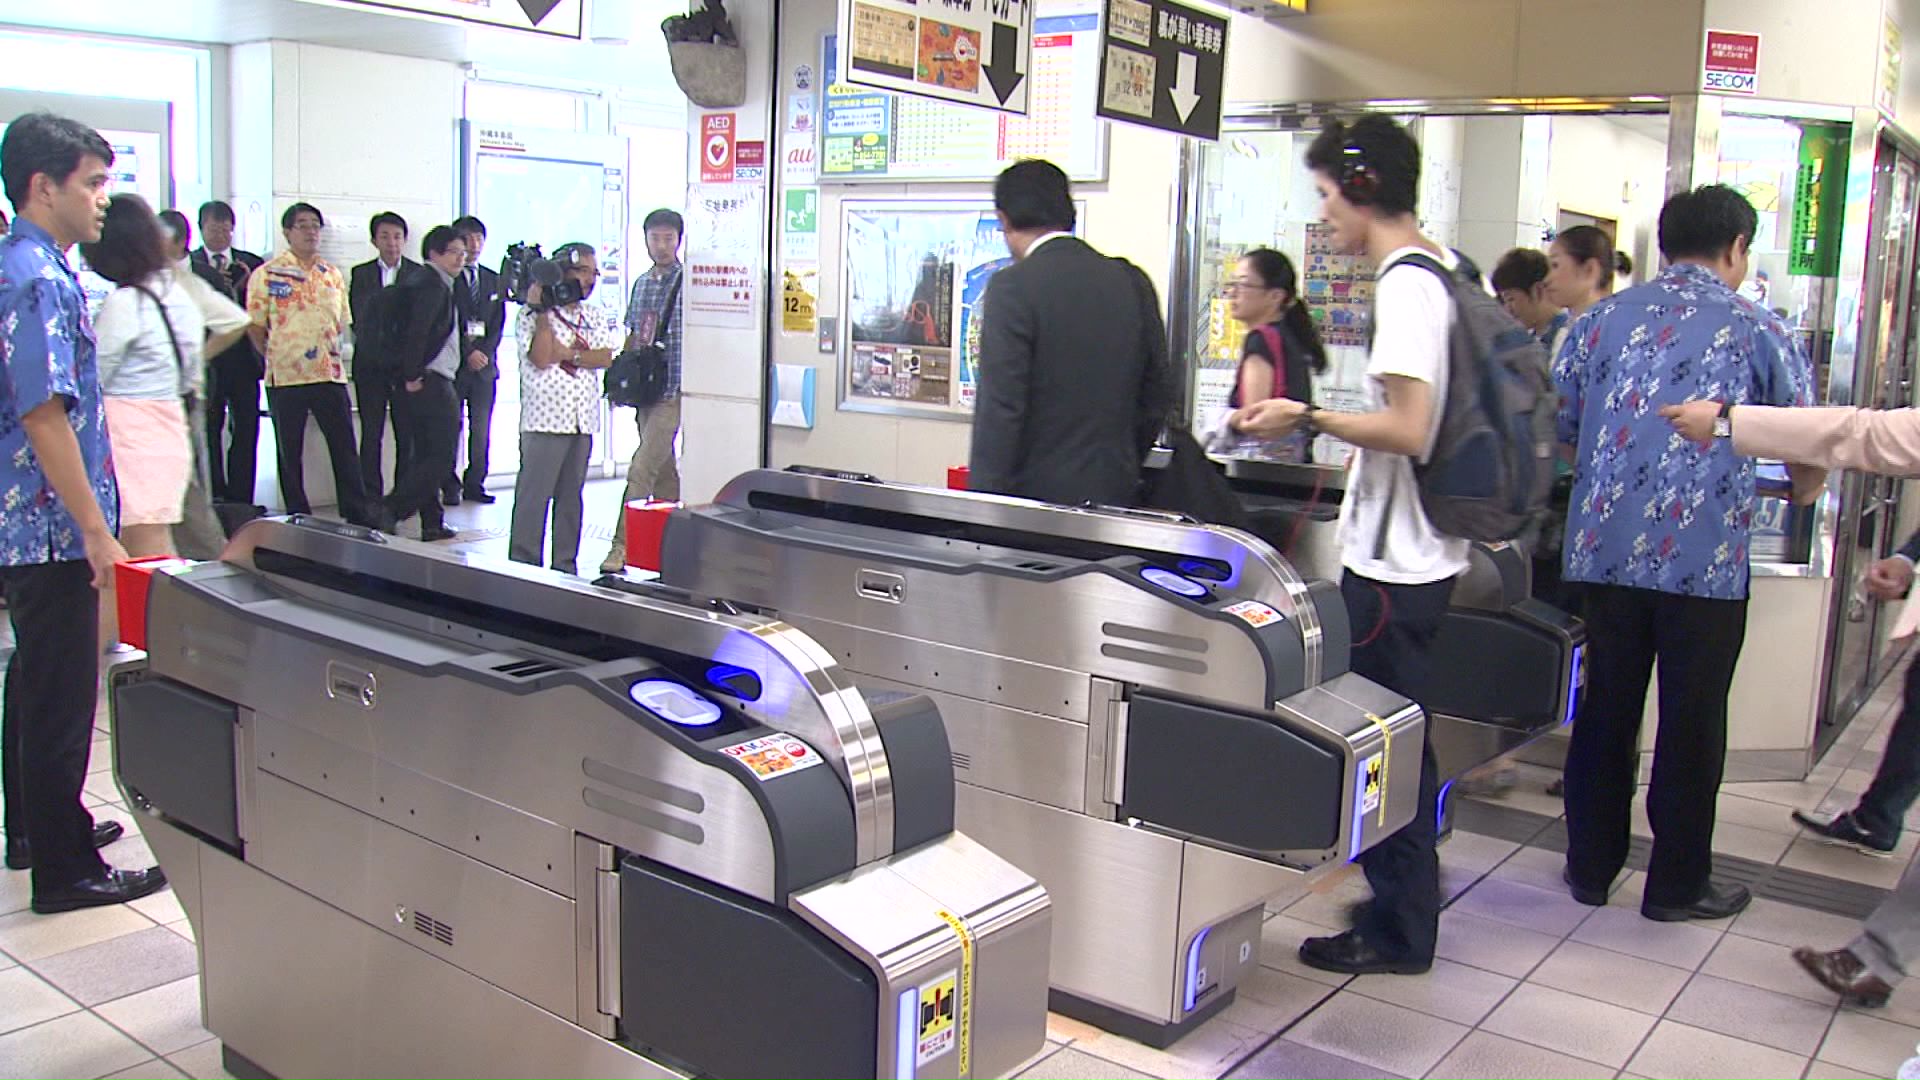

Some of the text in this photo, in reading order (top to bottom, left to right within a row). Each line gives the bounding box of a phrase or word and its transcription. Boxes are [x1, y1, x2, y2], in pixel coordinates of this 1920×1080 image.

[1706, 73, 1754, 89] SECOM
[707, 116, 730, 129] AED
[788, 148, 815, 164] au
[736, 168, 762, 178] SECOM
